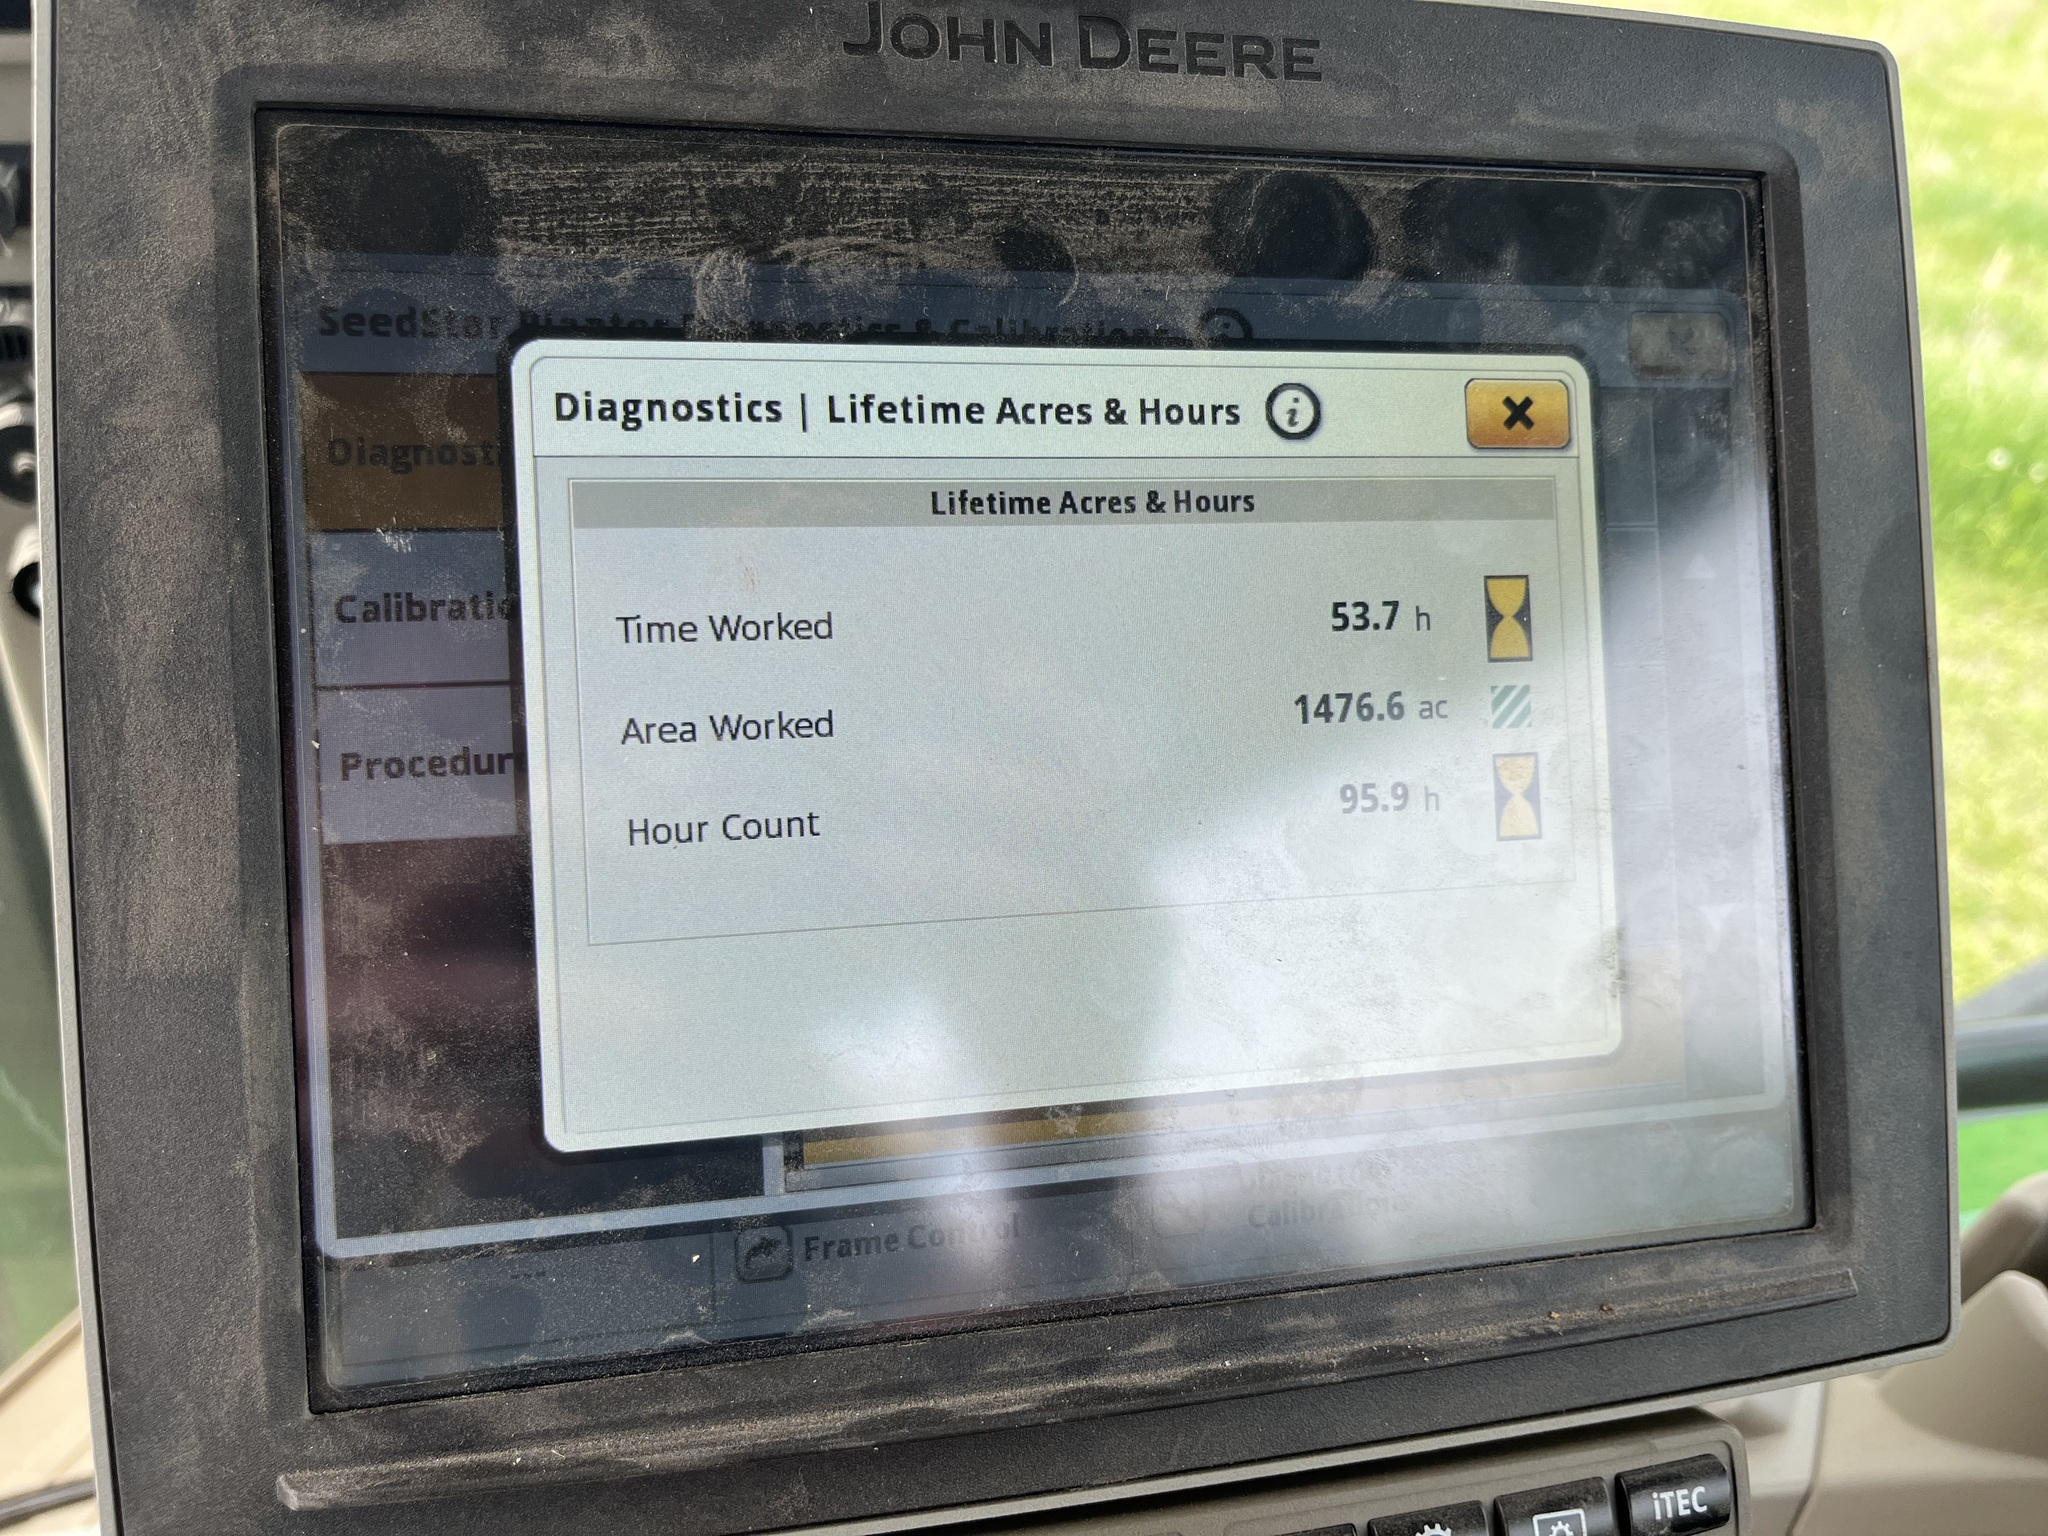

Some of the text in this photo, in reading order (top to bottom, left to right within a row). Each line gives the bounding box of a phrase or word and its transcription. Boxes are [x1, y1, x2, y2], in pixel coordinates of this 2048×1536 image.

[842, 0, 1323, 83] JOHN DEERE
[318, 306, 501, 339] SeedStar
[555, 390, 783, 432] Diagnostics
[828, 393, 985, 425] Lifetime
[995, 397, 1093, 426] Acres
[1104, 397, 1128, 426] &
[1139, 398, 1241, 426] Hours
[931, 489, 1256, 516] Lifetime Acres & Hours
[615, 611, 834, 645] Time Worked
[1331, 599, 1432, 632] 53.7 h
[1294, 691, 1449, 725] 1476.6 ac
[620, 709, 835, 746] Area Worked
[1339, 781, 1440, 815] 95.9 h
[628, 812, 821, 846] Hour Count
[803, 1231, 900, 1262] Frame
[1652, 1485, 1709, 1520] iTEC
